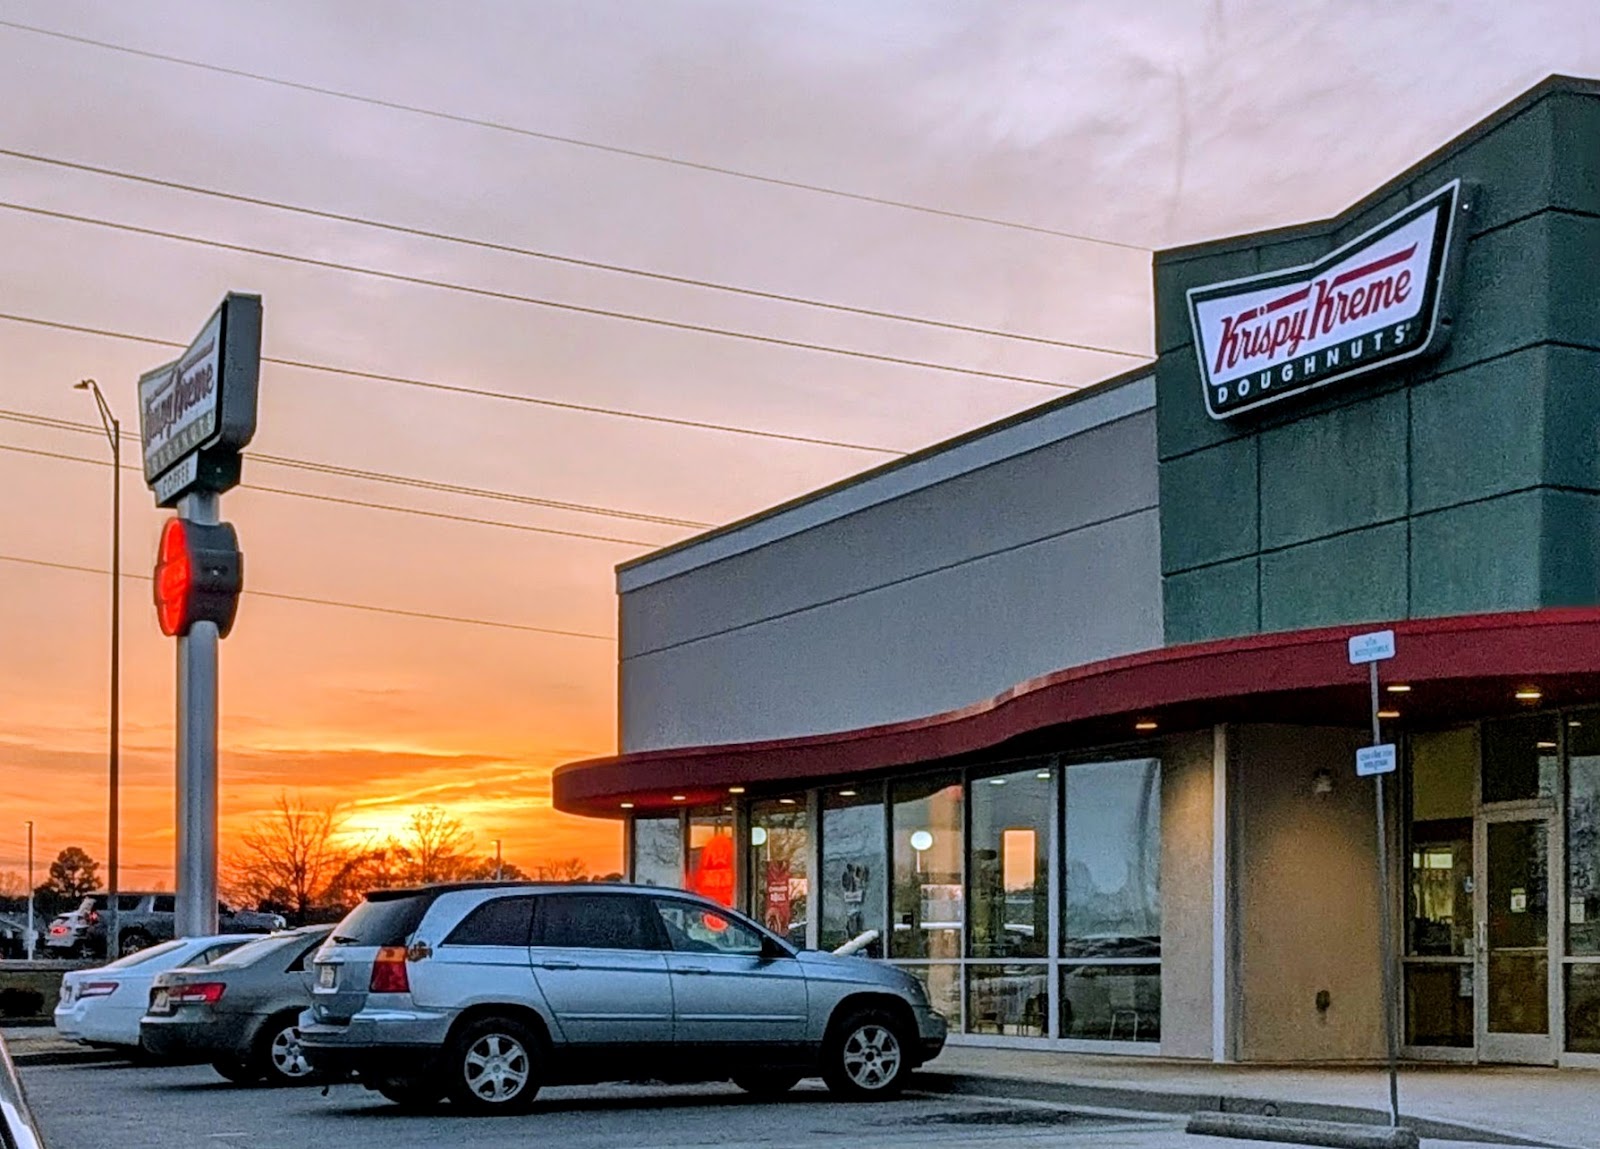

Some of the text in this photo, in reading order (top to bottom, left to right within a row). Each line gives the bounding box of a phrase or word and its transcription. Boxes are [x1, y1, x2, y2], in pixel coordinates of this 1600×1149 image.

[1214, 242, 1418, 375] Krispy Kreme
[1218, 325, 1404, 403] DOUGHNUTS
[145, 369, 177, 448] Kpy
